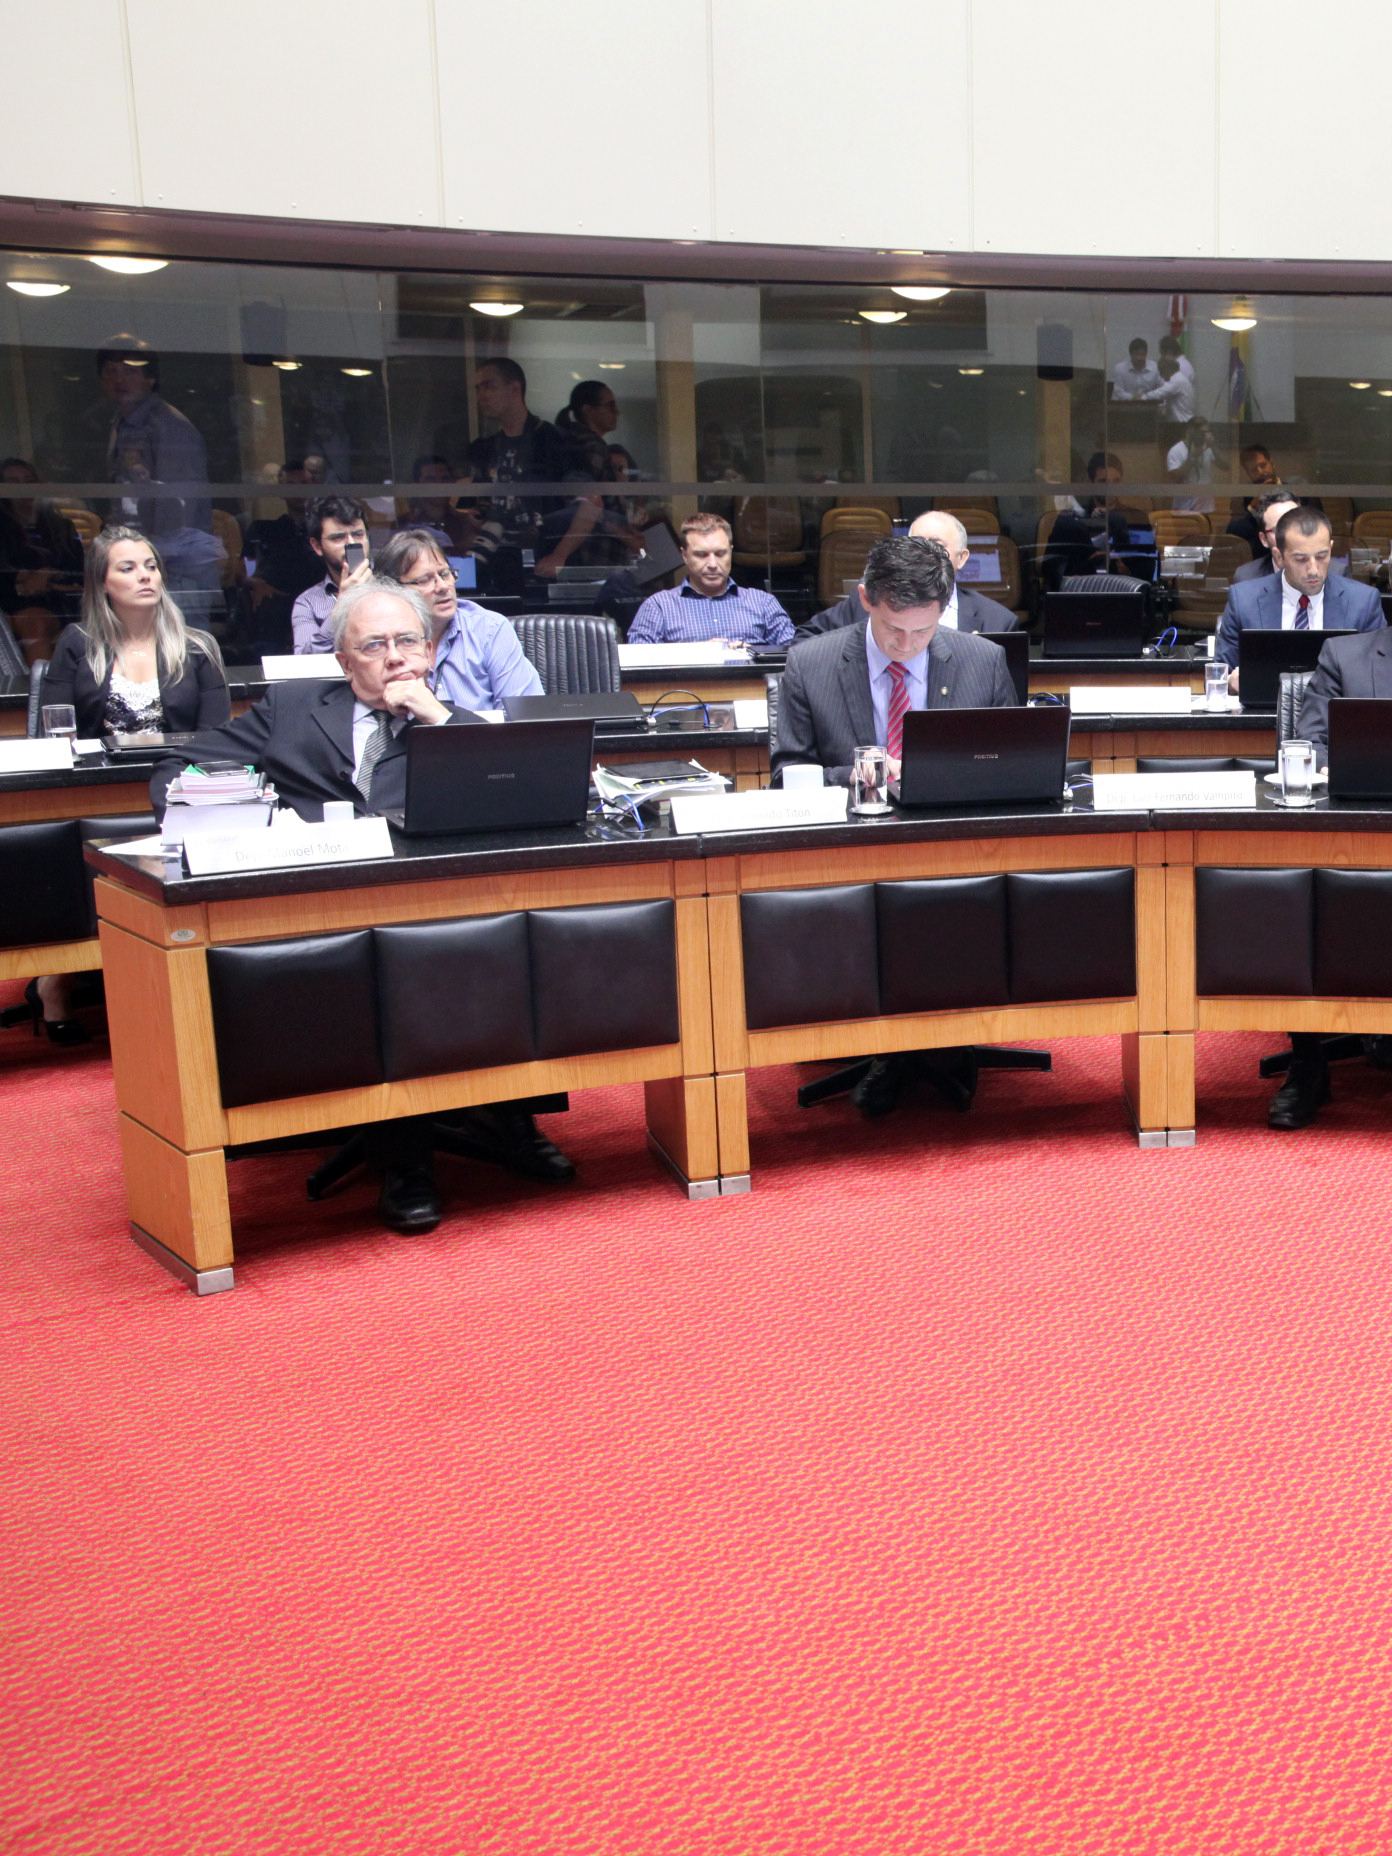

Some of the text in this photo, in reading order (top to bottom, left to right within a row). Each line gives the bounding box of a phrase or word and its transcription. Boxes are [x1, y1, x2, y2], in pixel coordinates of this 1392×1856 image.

[1154, 791, 1200, 802] Fernando
[1202, 791, 1244, 804] Vampiro
[784, 808, 811, 818] Titon
